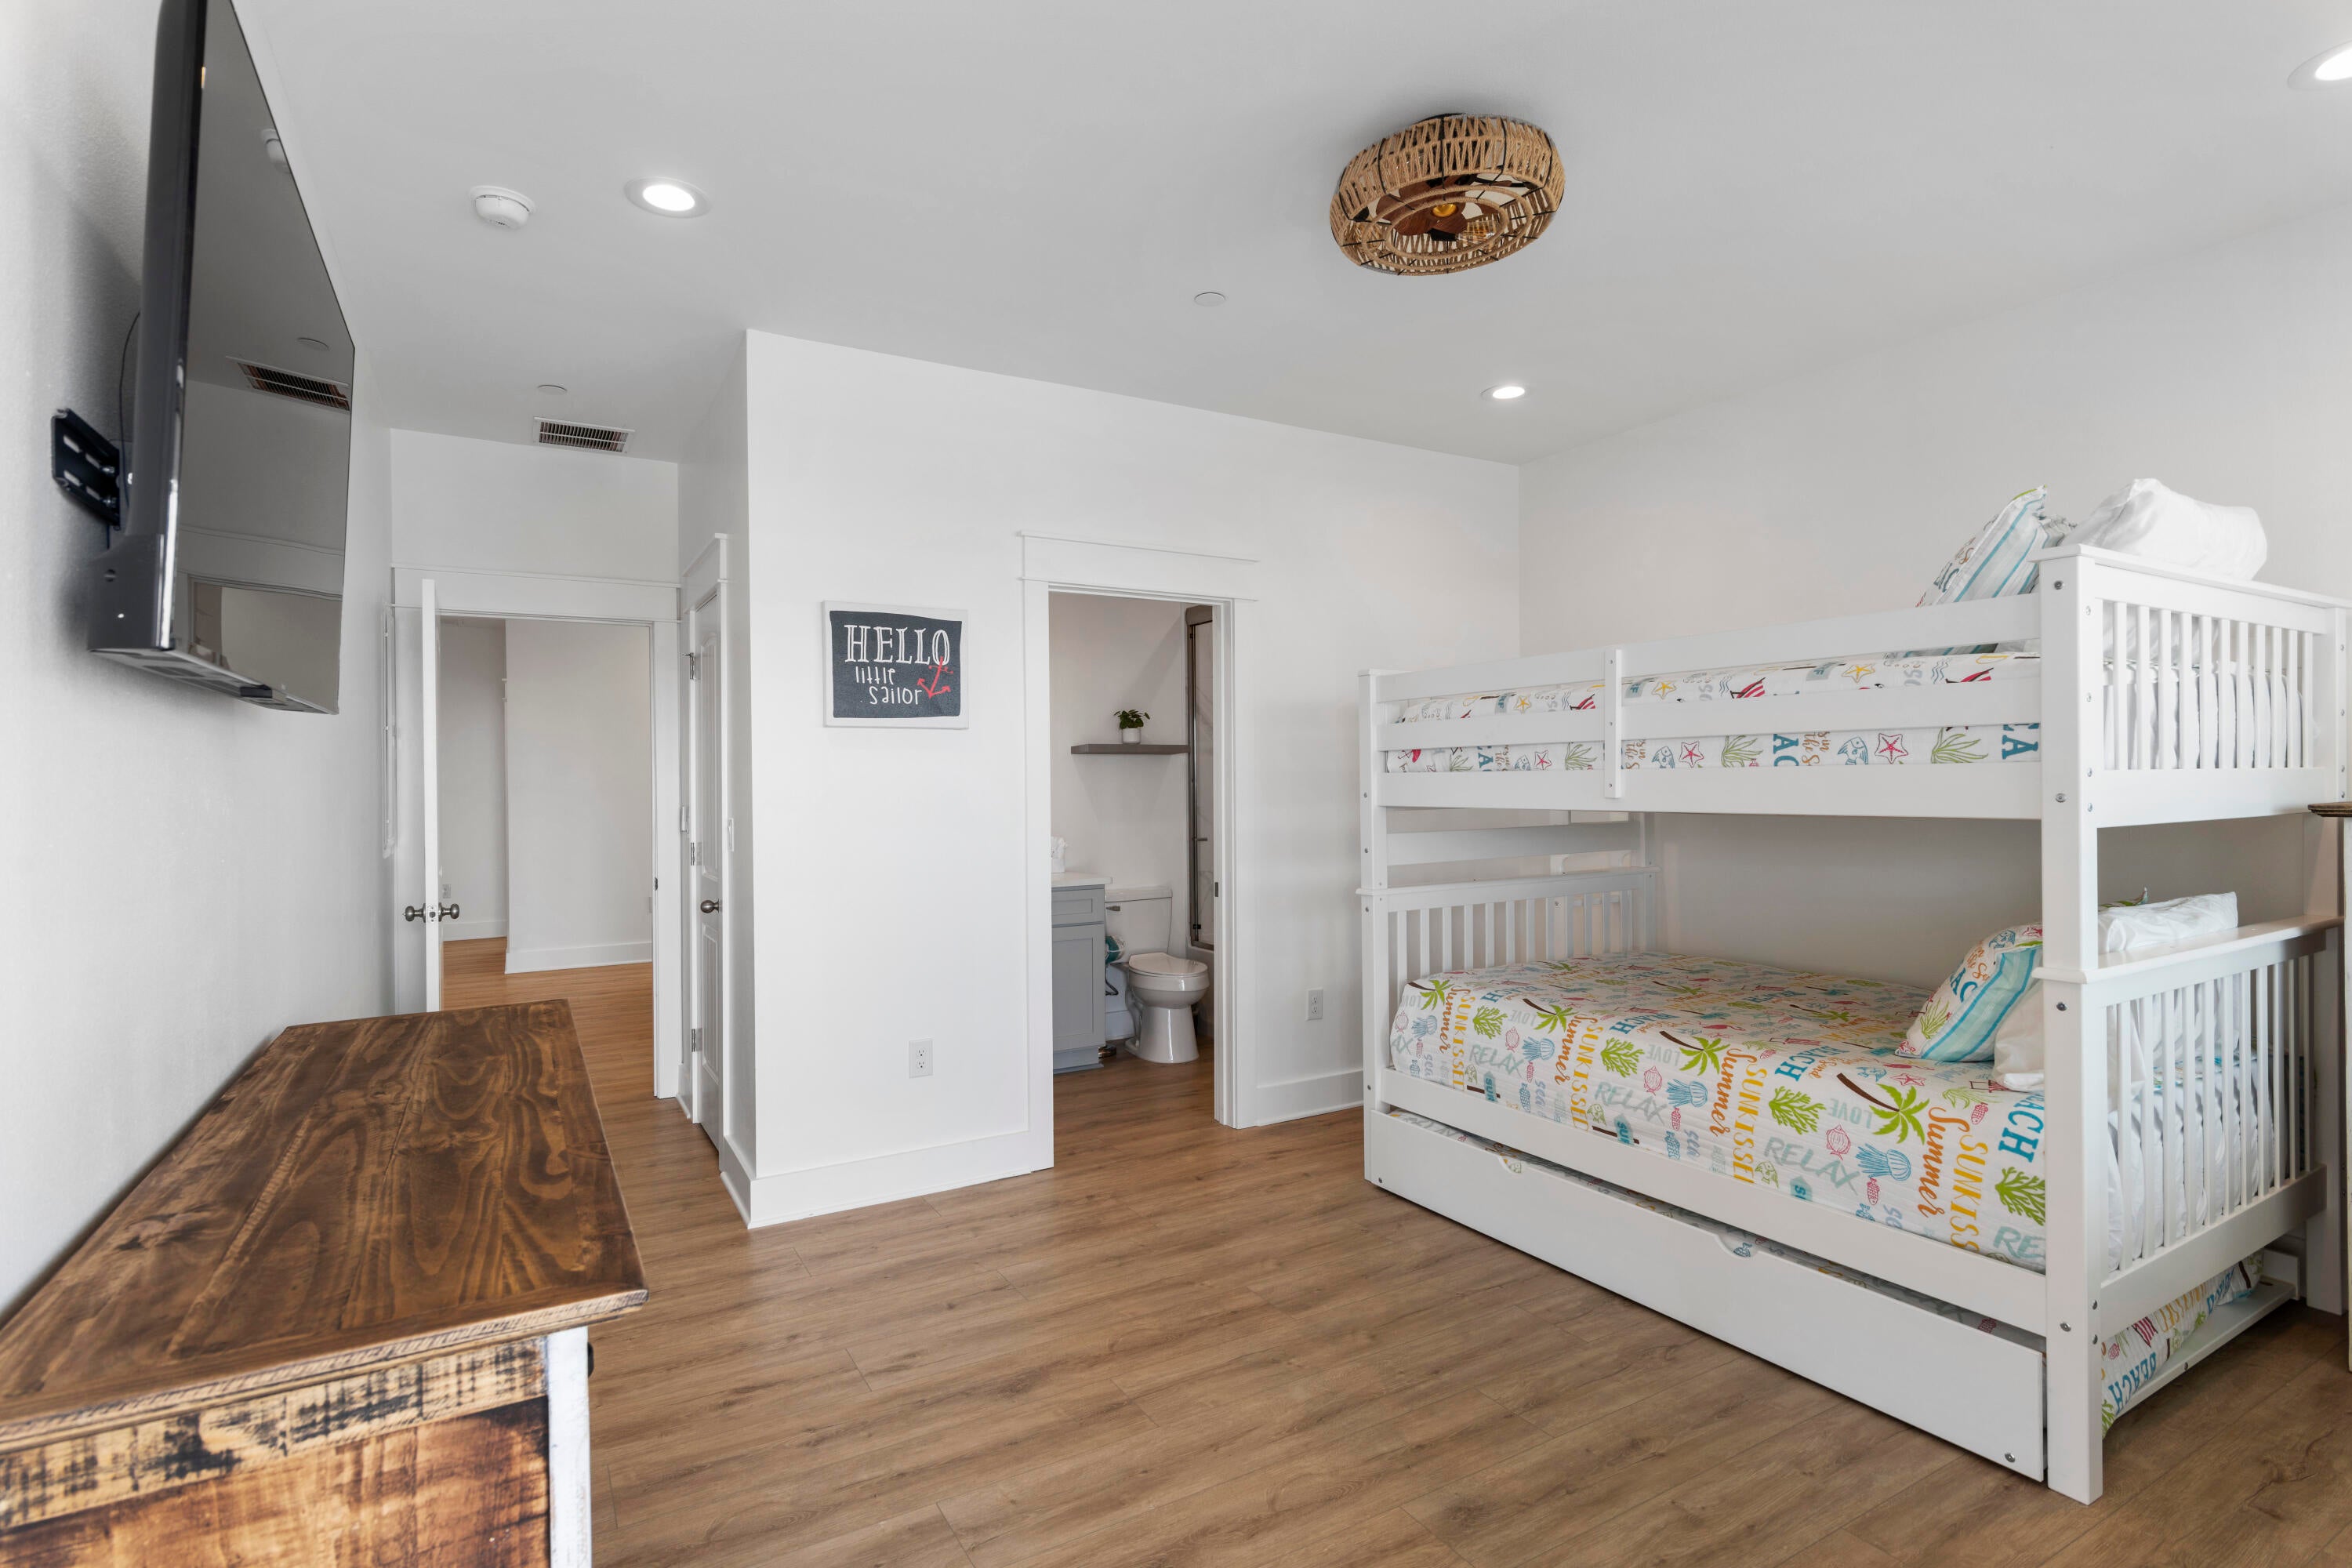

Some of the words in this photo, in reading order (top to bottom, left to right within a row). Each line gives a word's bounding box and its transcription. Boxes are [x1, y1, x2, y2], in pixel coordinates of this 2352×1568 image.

[844, 624, 950, 666] HELLO
[855, 666, 896, 685] little
[869, 685, 923, 706] sailor
[1439, 985, 1472, 1054] Summer
[1468, 1043, 1525, 1080] RELAX
[1554, 1014, 1599, 1086] Summer
[1646, 1043, 1680, 1068] LOVE
[1774, 1045, 1850, 1083] BEACH
[1594, 1080, 1668, 1127] RELAX
[1708, 1047, 1759, 1138] Summer
[1828, 1098, 1876, 1130] LOVE
[1762, 1136, 1862, 1196] RELAX
[1917, 1105, 1971, 1219] Summer
